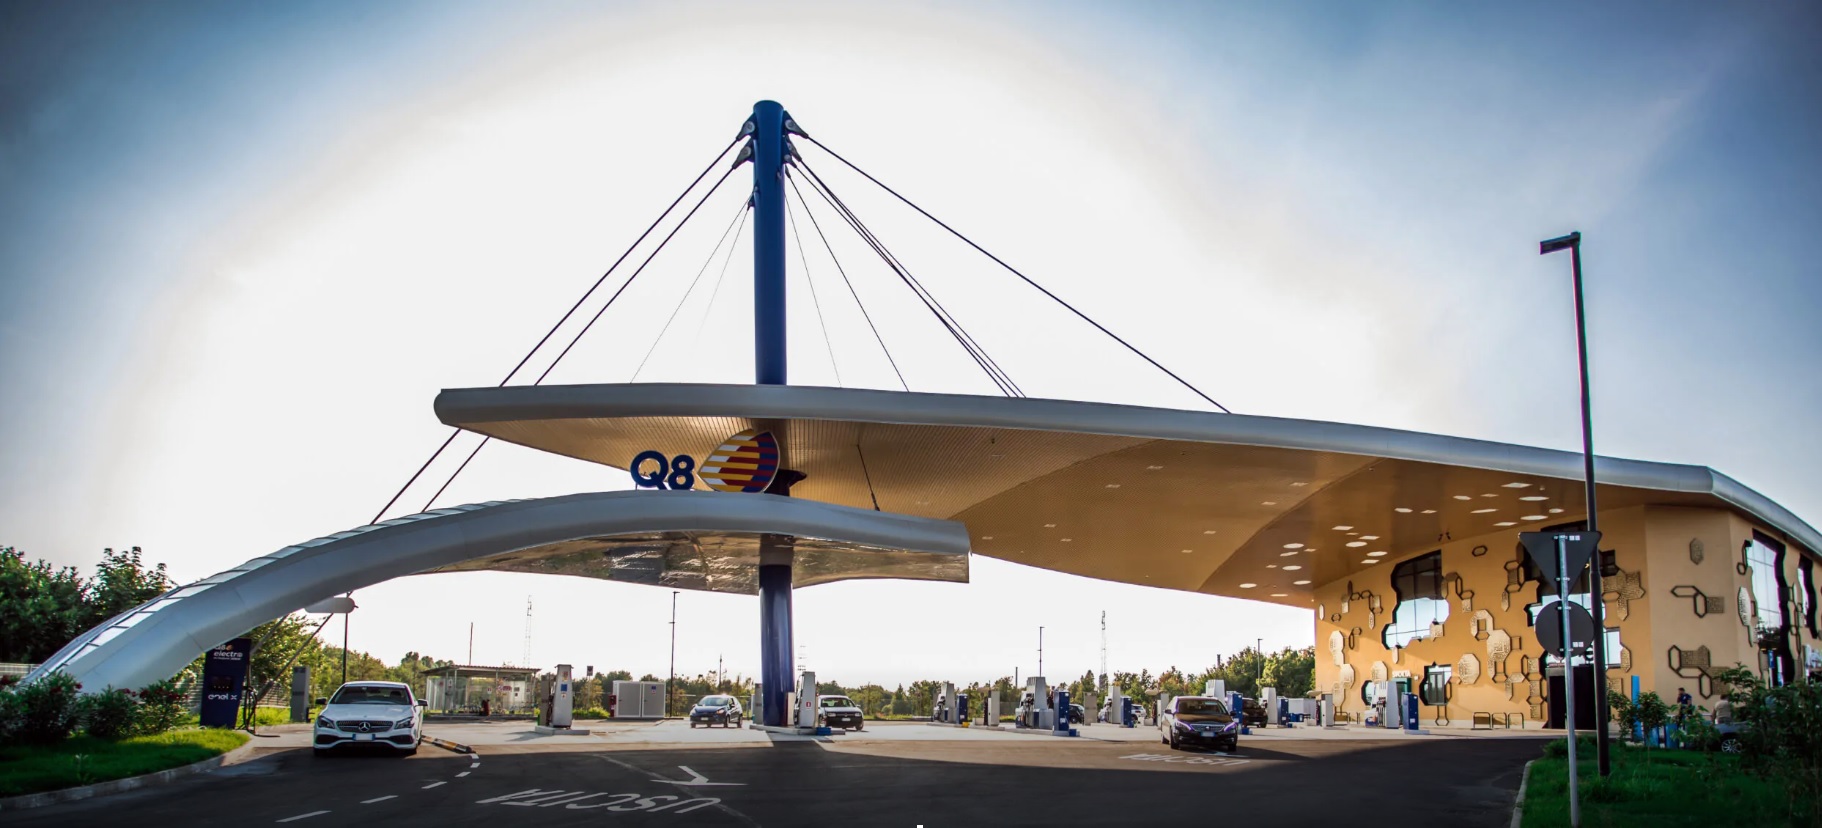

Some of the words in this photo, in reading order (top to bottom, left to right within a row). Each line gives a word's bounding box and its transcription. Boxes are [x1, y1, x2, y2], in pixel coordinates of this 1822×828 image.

[630, 450, 695, 490] Q8
[213, 650, 243, 658] electro
[475, 788, 721, 813] USCITA
